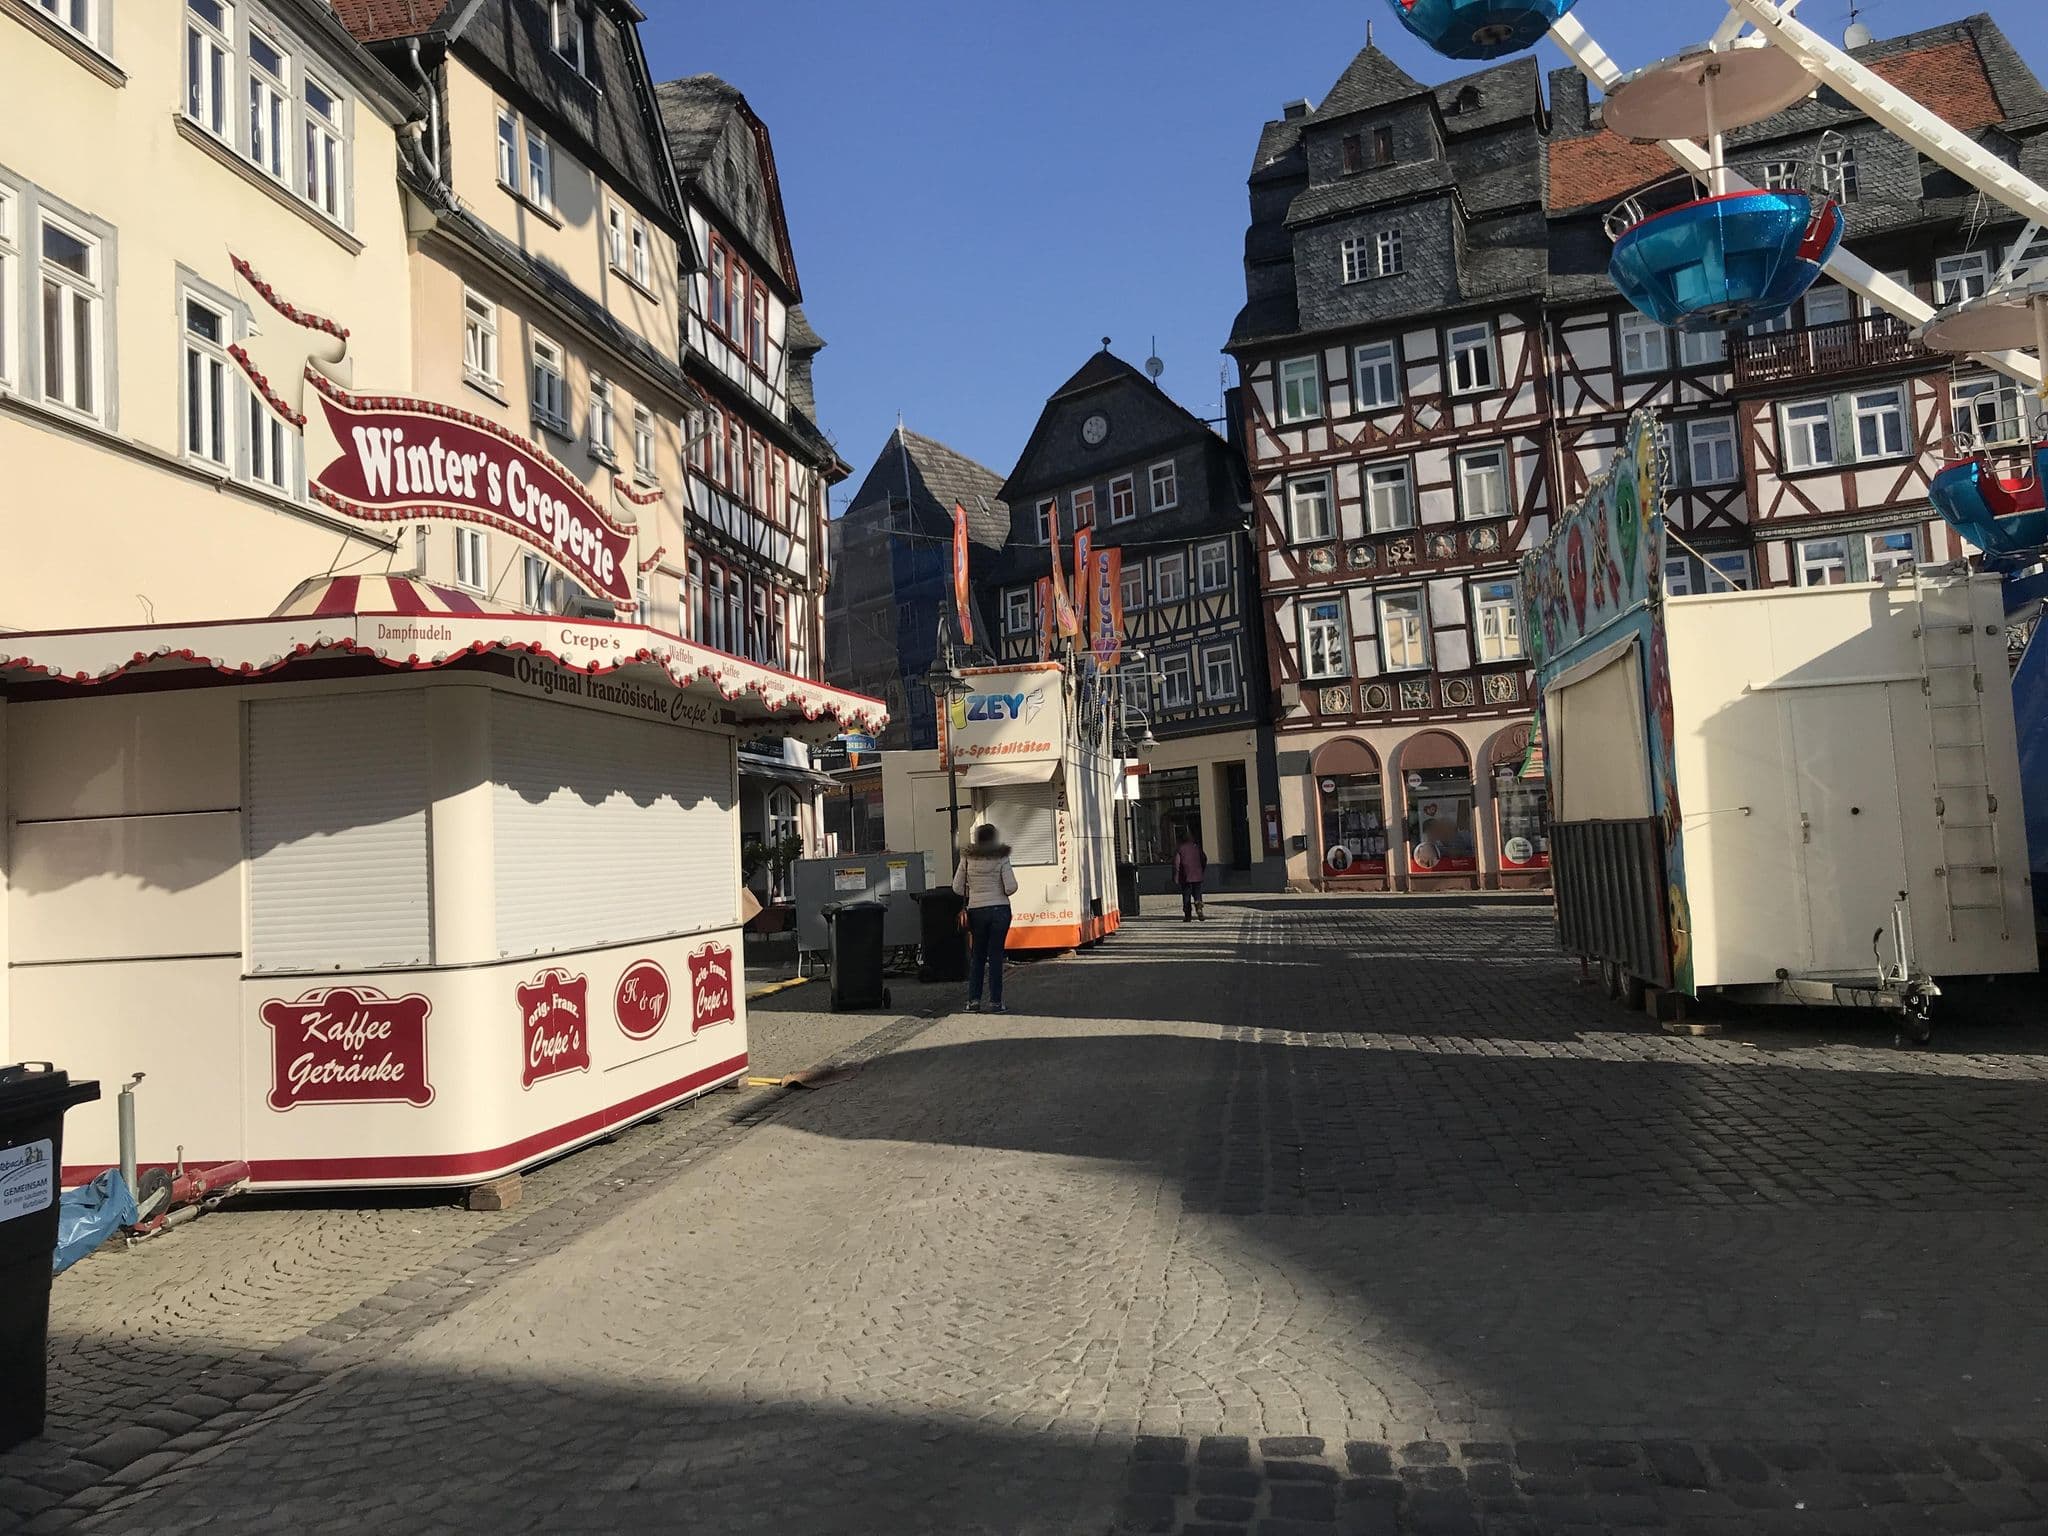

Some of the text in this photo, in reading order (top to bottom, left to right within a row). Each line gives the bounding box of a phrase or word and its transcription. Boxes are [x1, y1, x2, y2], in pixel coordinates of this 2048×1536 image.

[351, 424, 614, 586] Winter's Creperie
[1098, 551, 1114, 638] SLUSH
[377, 623, 452, 643] Dampfnudeln
[560, 629, 621, 650] Crepe's
[668, 645, 694, 665] Waffeln
[721, 661, 741, 679] Kaffee
[517, 656, 720, 728] Original französische Crepe's
[966, 692, 1025, 722] ZEY
[953, 740, 1052, 759] is-Spezialitäten
[1057, 791, 1068, 883] Zuckerwatte
[708, 960, 728, 981] Franz.
[528, 992, 580, 1028] orig. Franz.
[622, 977, 665, 1020] K & W
[696, 986, 728, 1019] Crepe's
[300, 1011, 392, 1051] Kaffee
[530, 1024, 580, 1068] Crepe's
[287, 1051, 405, 1095] Getränke
[3, 1177, 48, 1197] GEMEINSAM
